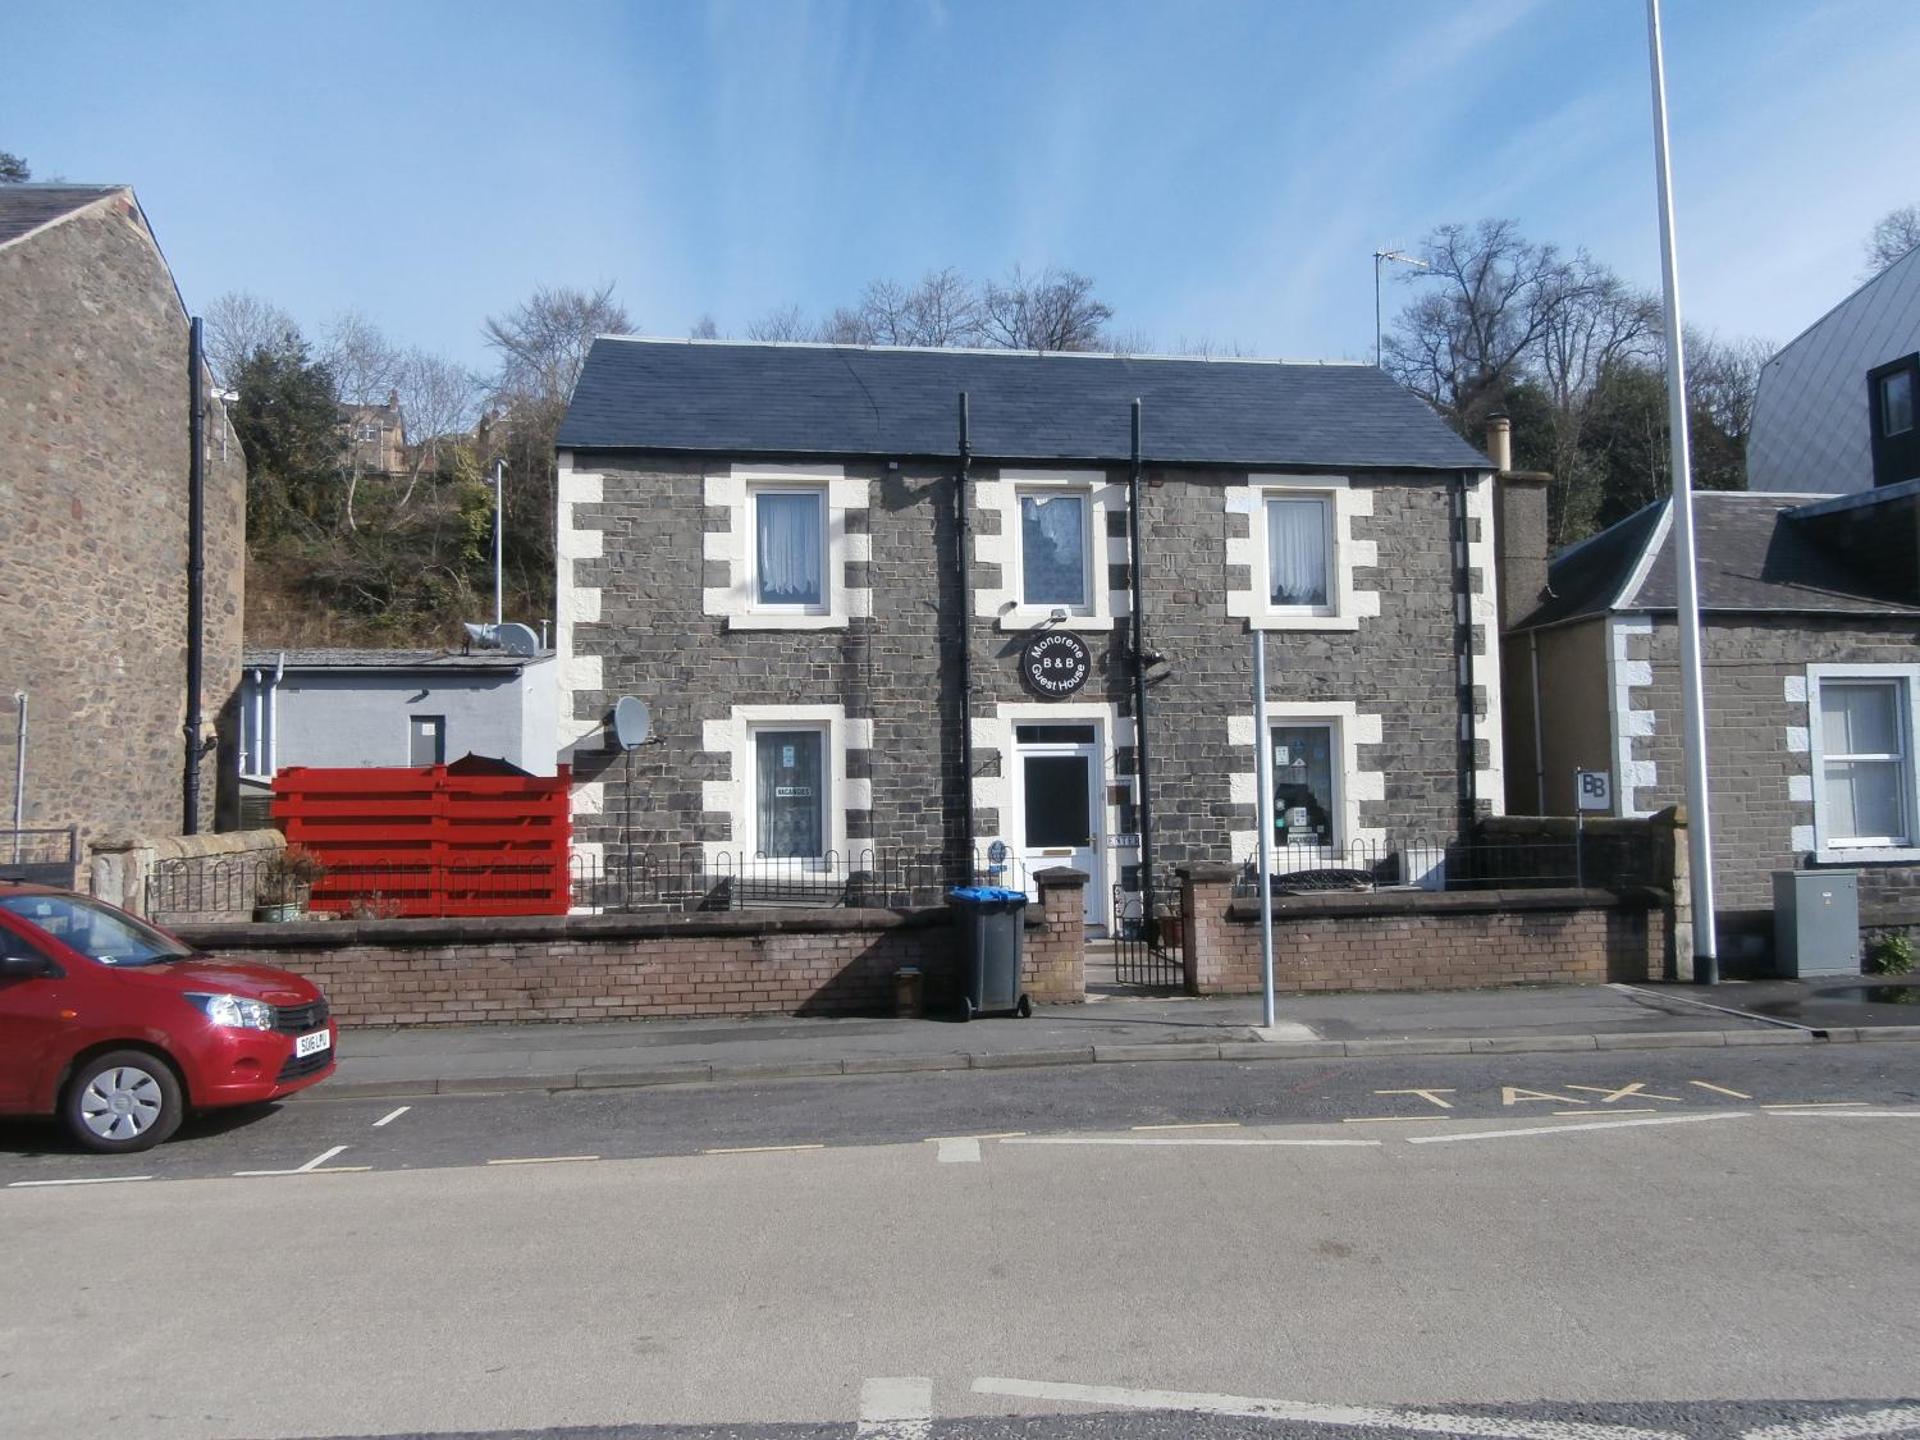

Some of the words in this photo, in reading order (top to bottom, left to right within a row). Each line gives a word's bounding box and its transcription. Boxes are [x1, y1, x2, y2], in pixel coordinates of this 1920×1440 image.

[1031, 635, 1084, 659] Monorene
[1043, 657, 1052, 668] B
[1054, 657, 1063, 668] &
[1065, 657, 1074, 668] B
[1031, 663, 1057, 690] Guest
[1058, 663, 1085, 690] House
[1374, 1081, 1753, 1109] TAXI
